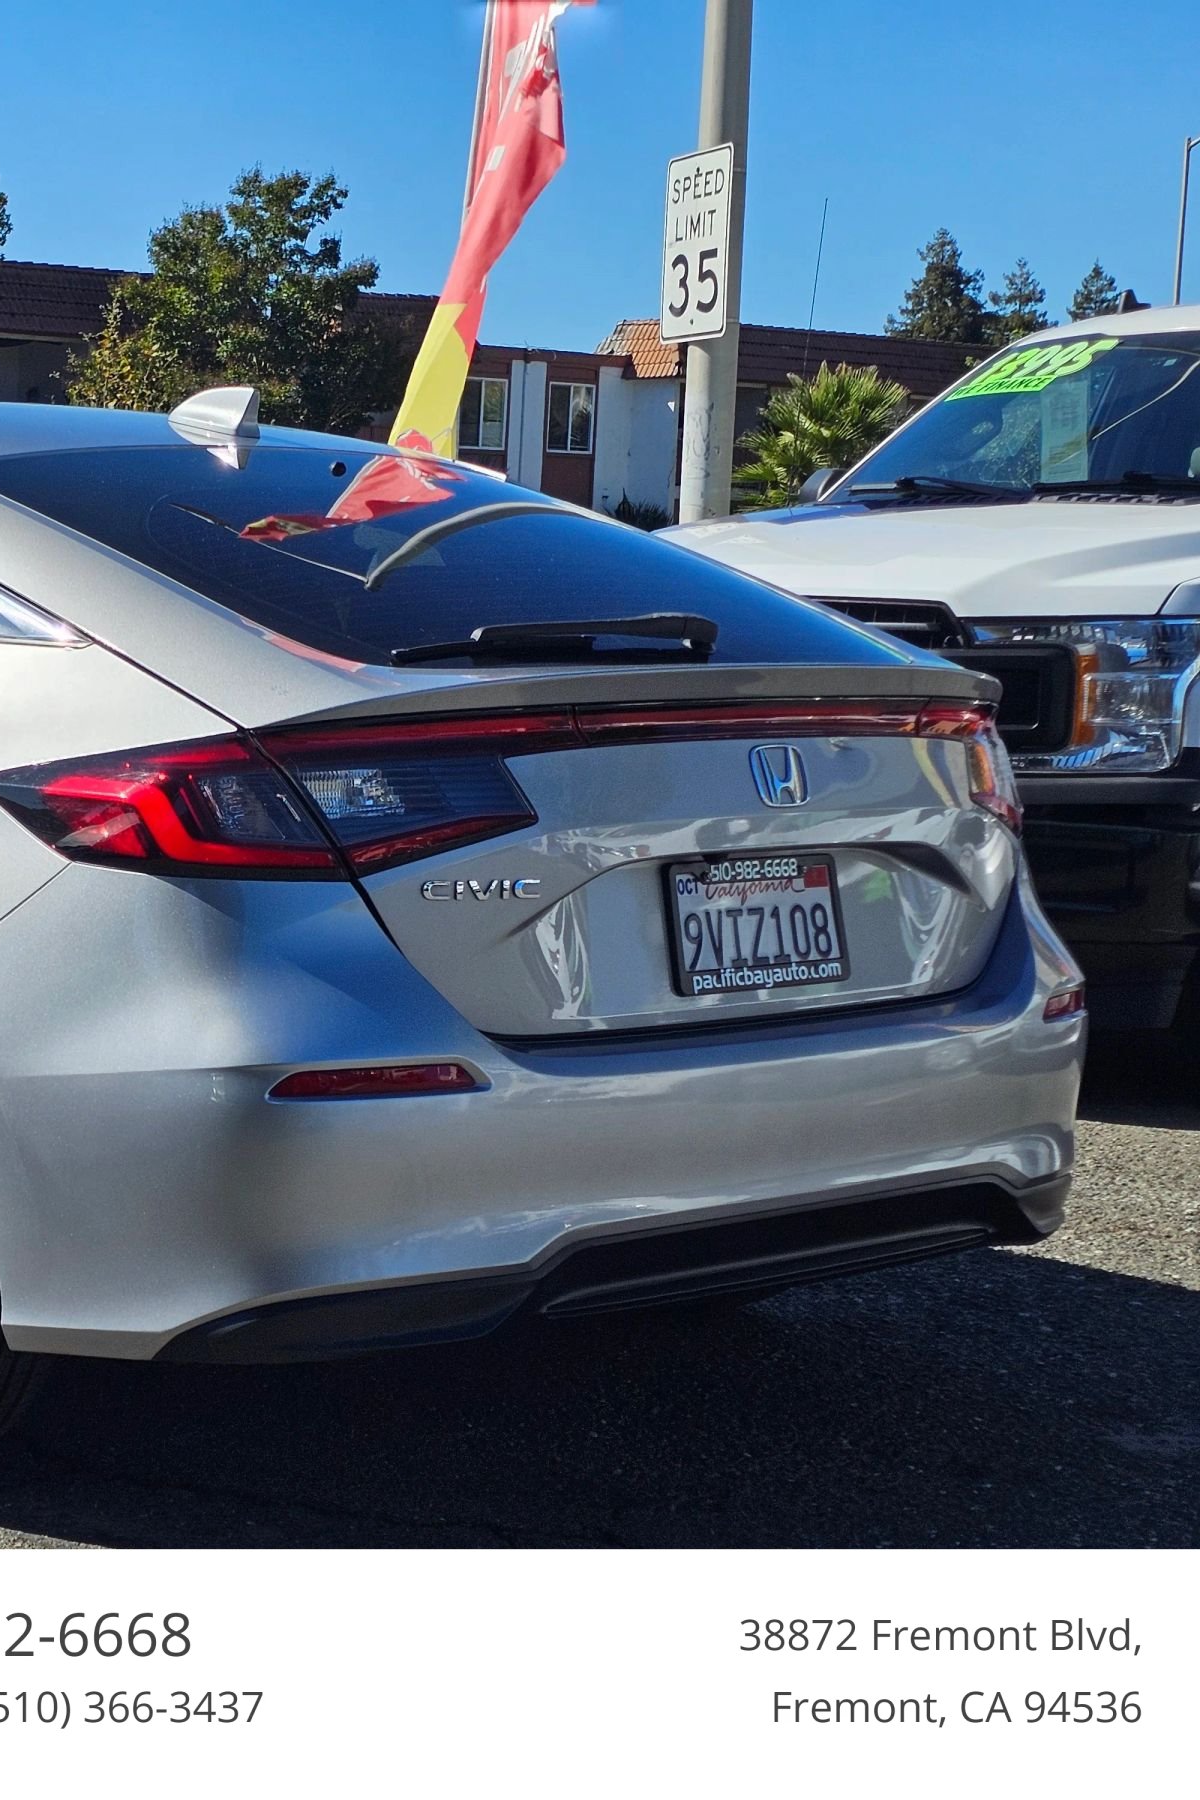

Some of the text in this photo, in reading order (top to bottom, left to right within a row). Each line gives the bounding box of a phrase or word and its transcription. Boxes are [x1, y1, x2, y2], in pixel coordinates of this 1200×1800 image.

[672, 168, 725, 204] SPEED
[675, 209, 717, 242] LIMIT
[668, 248, 719, 318] 35
[977, 377, 1050, 393] FINANCE
[710, 858, 798, 882] 510-982-6668
[421, 879, 541, 900] CIVIC
[677, 879, 699, 896] OCT
[684, 903, 832, 970] 9VIZ108
[692, 962, 842, 995] pacificbayauto.com
